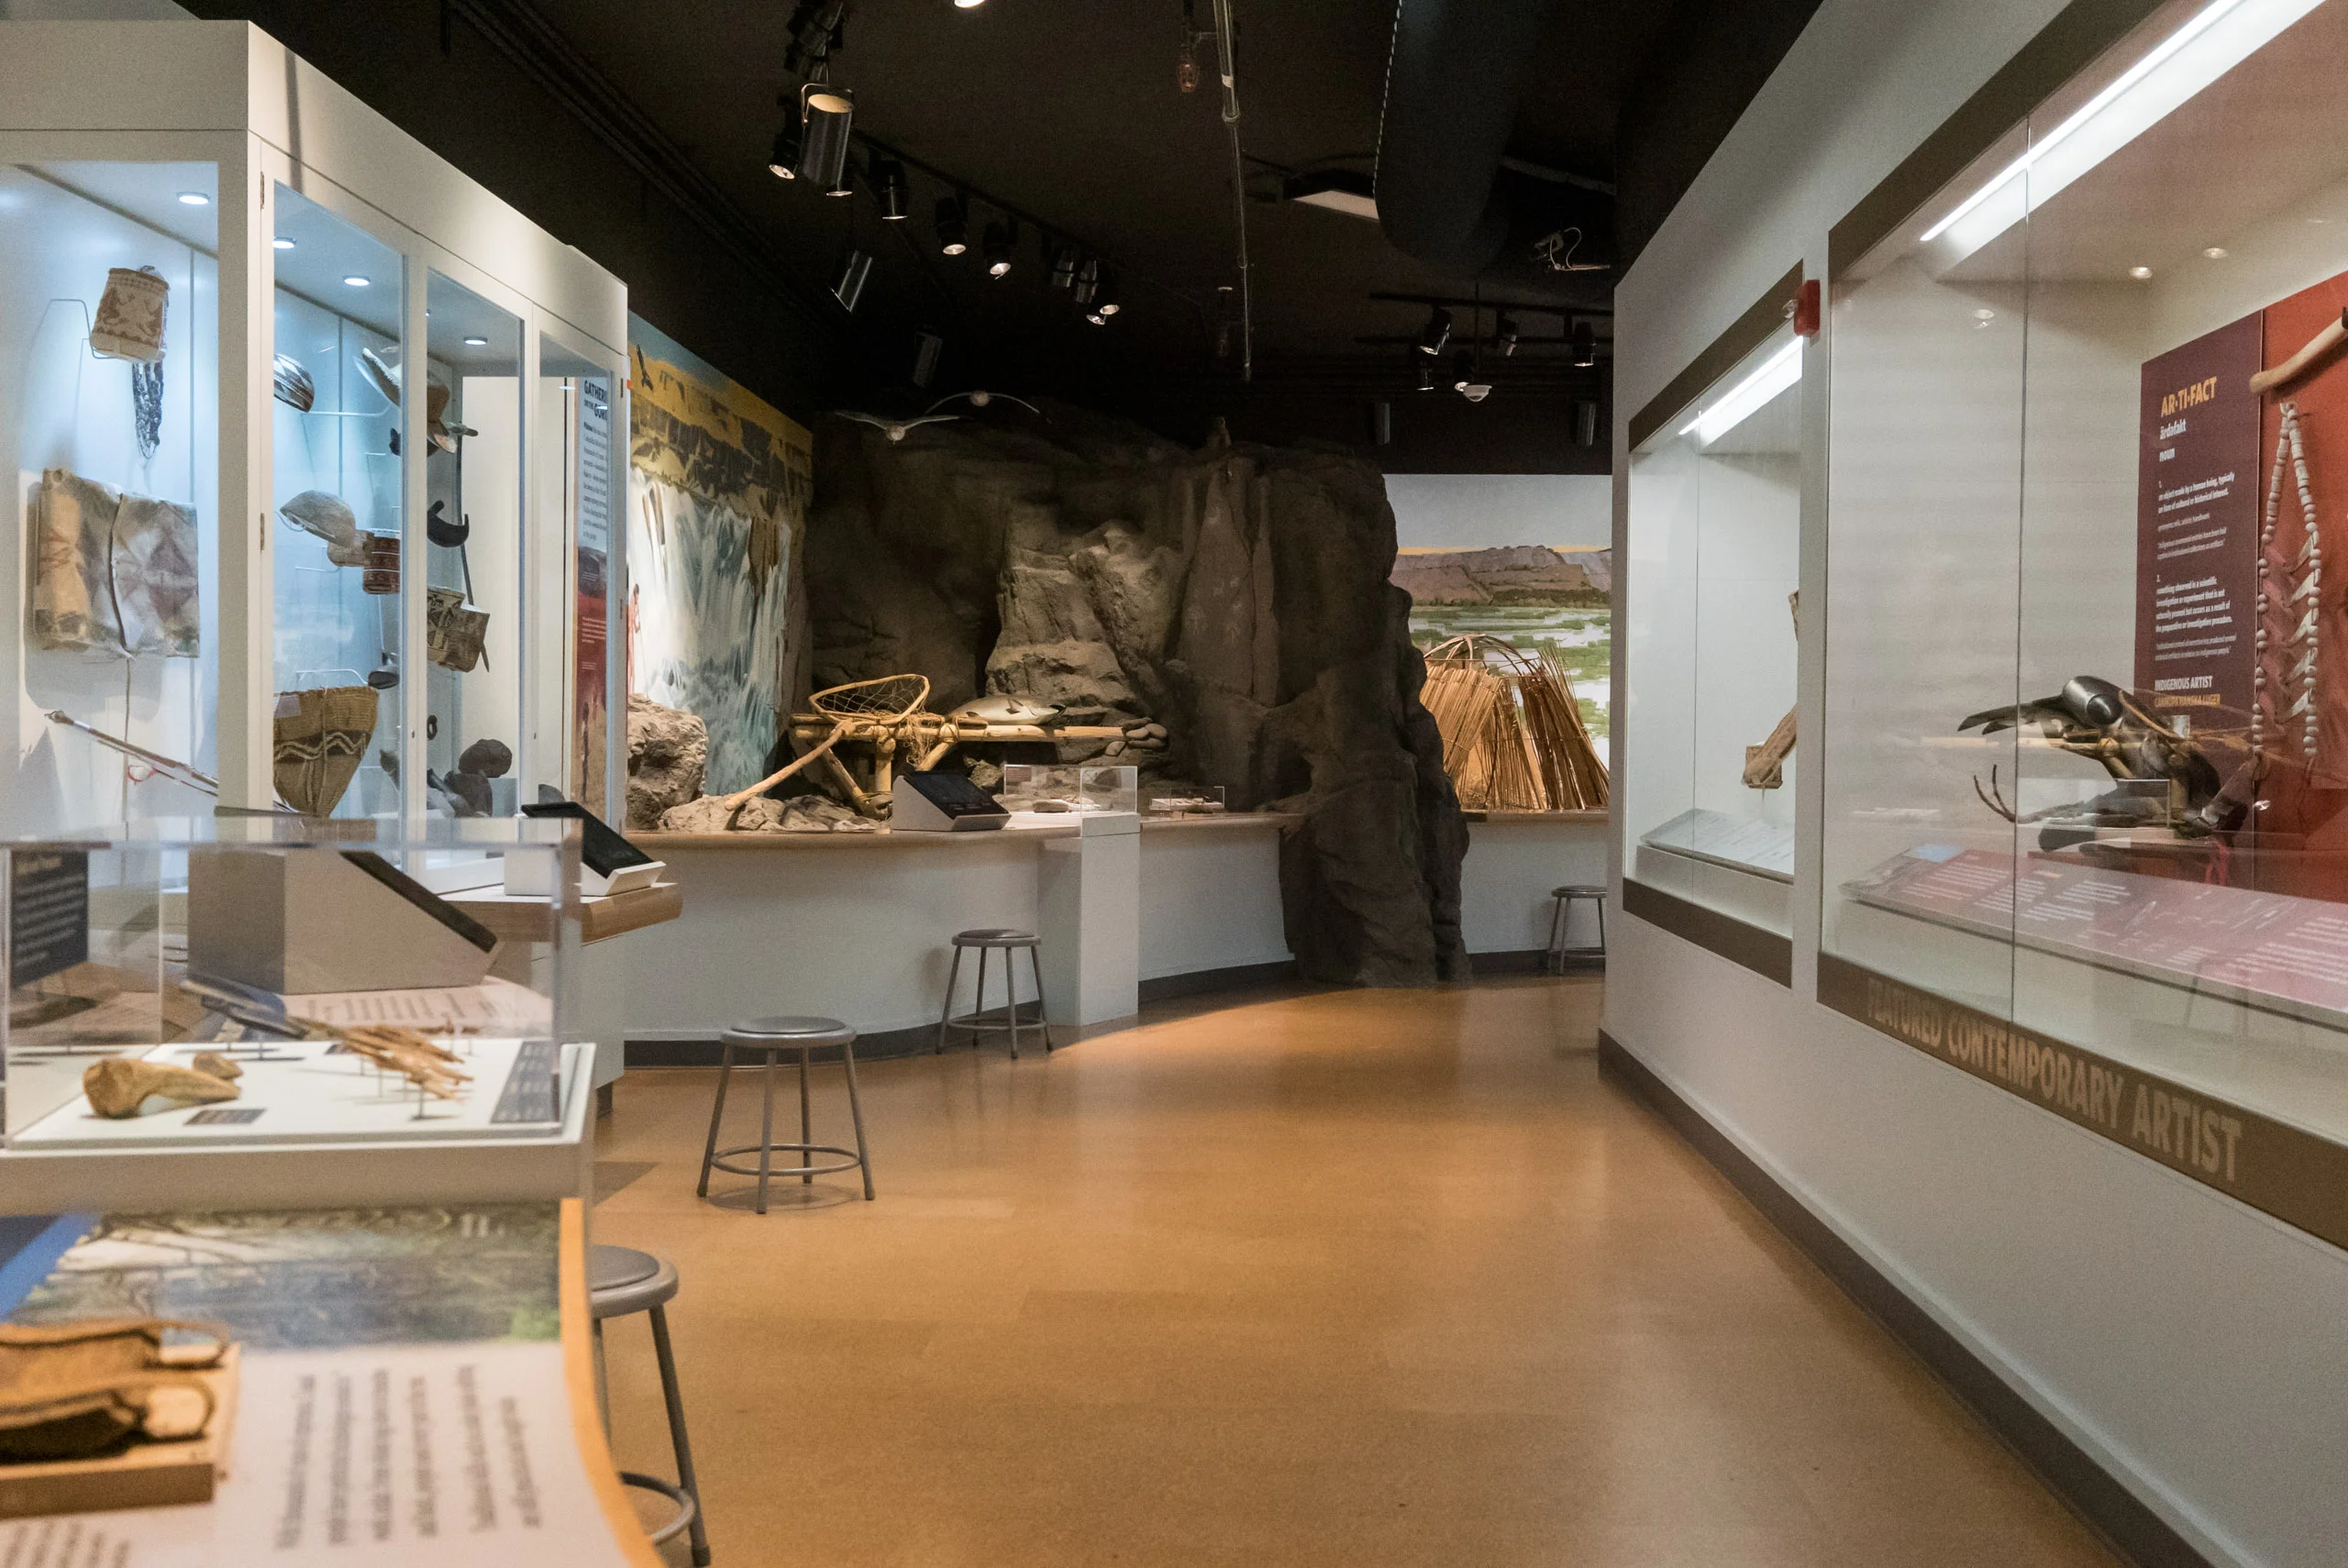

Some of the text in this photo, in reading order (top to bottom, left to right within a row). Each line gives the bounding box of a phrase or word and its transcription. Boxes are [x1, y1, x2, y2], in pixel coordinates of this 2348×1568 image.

[2154, 675, 2213, 691] INDIGENOUS ARTIST
[1866, 977, 2243, 1182] FEATURED CONTEMPORARY ARTIST
